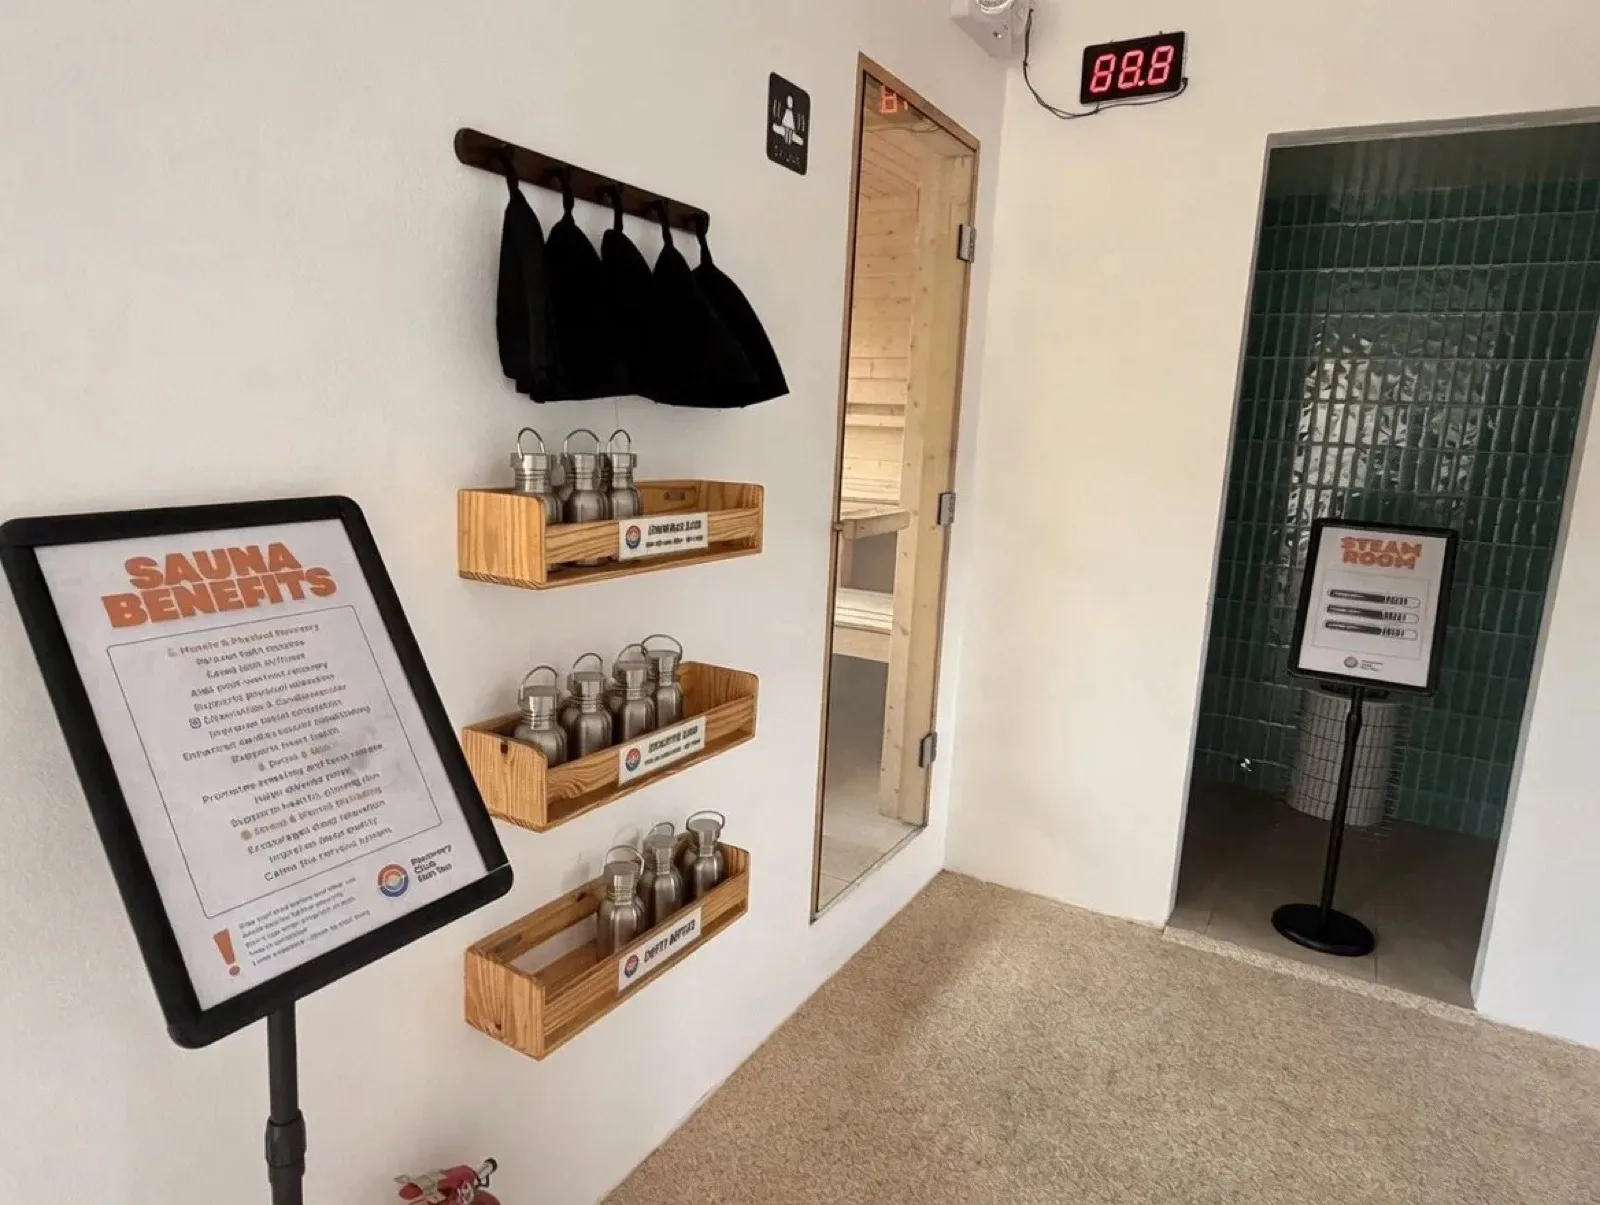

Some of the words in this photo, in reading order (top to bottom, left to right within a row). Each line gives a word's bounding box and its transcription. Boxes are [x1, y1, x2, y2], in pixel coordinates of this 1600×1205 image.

[1089, 45, 1175, 93] 88.8
[124, 541, 303, 589] SAUNA
[1340, 536, 1422, 557] STEAM
[1342, 550, 1416, 570] ROOM
[101, 567, 337, 629] BENEFITS
